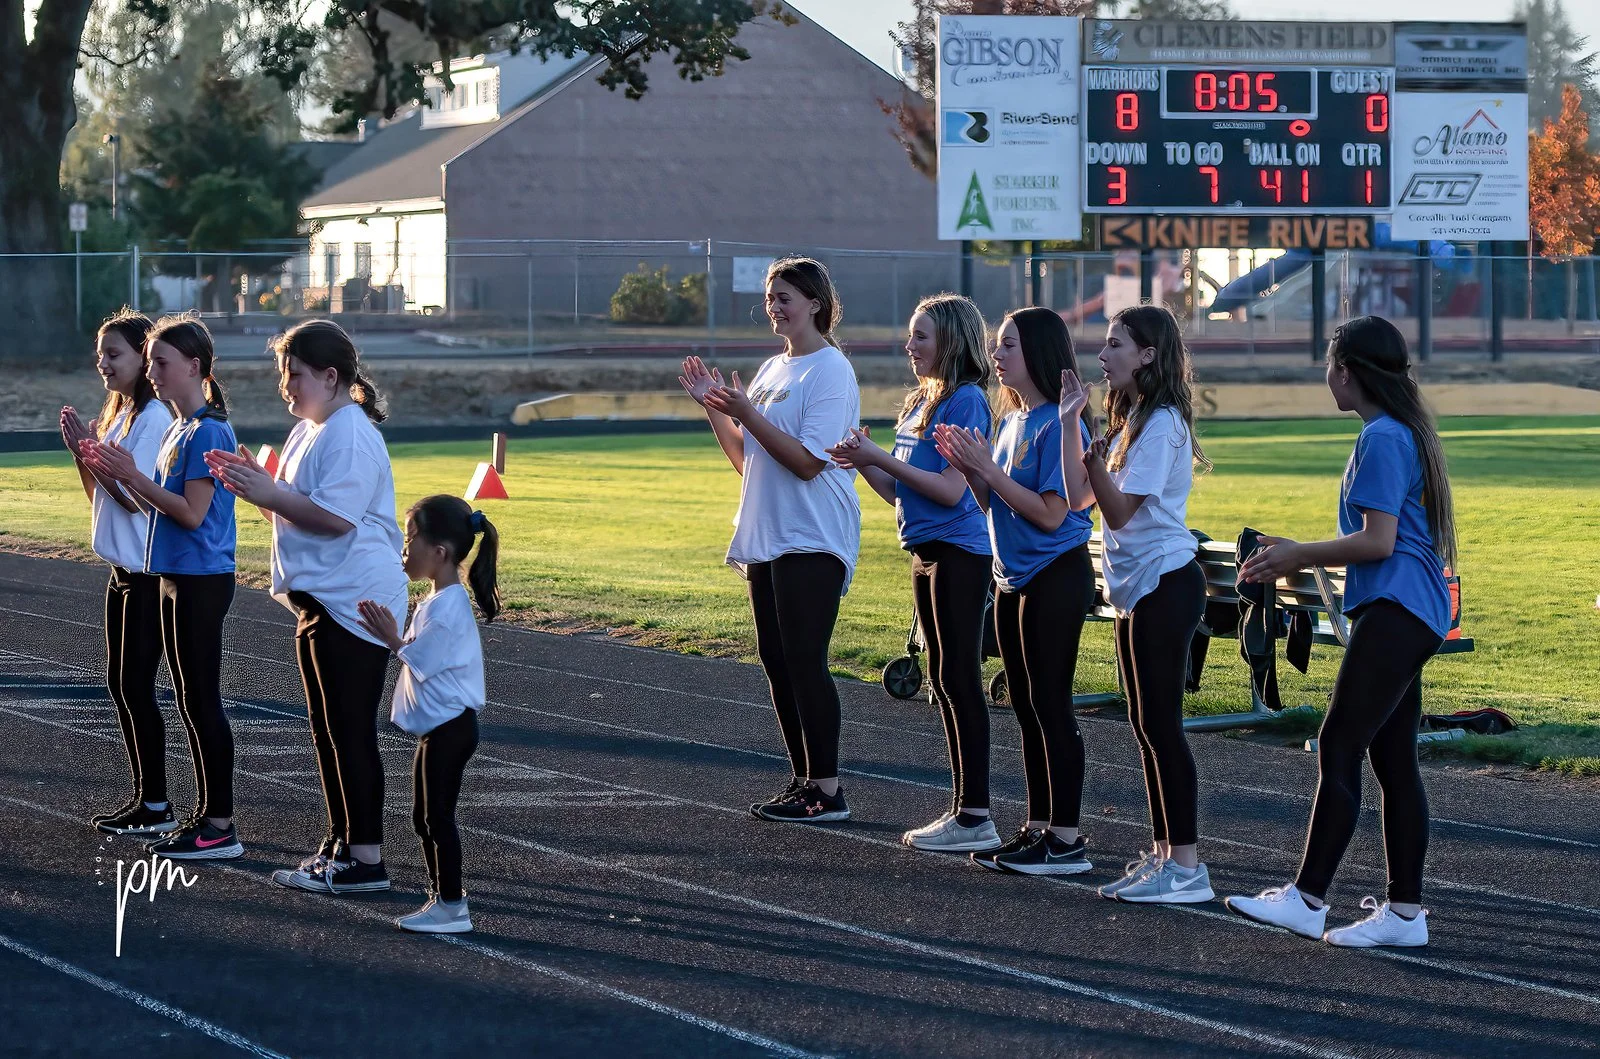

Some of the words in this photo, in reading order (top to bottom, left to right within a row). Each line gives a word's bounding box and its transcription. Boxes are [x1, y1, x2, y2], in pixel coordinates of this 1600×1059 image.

[943, 37, 1064, 67] GIBSON
[1133, 25, 1284, 48] CLEMENS
[1296, 25, 1388, 49] FIELD
[1087, 69, 1159, 91] WARRIORS
[1194, 72, 1279, 112] 8:05
[1330, 70, 1391, 94] GUEST
[1115, 92, 1139, 131] 8
[1365, 94, 1389, 132] 0
[1087, 141, 1148, 165] DOWN
[1163, 141, 1190, 165] TO
[1194, 141, 1224, 166] GO
[1248, 142, 1293, 167] BALL
[1295, 142, 1321, 167] ON
[1341, 142, 1382, 167] QTR
[1413, 124, 1508, 157] Alamo
[1107, 166, 1127, 205] 3
[1198, 166, 1220, 203] 7
[1259, 169, 1310, 204] 41
[1364, 169, 1373, 204] 1
[1409, 180, 1472, 199] CTC
[1148, 217, 1250, 247] KNIFE
[1269, 218, 1371, 248] RIVER
